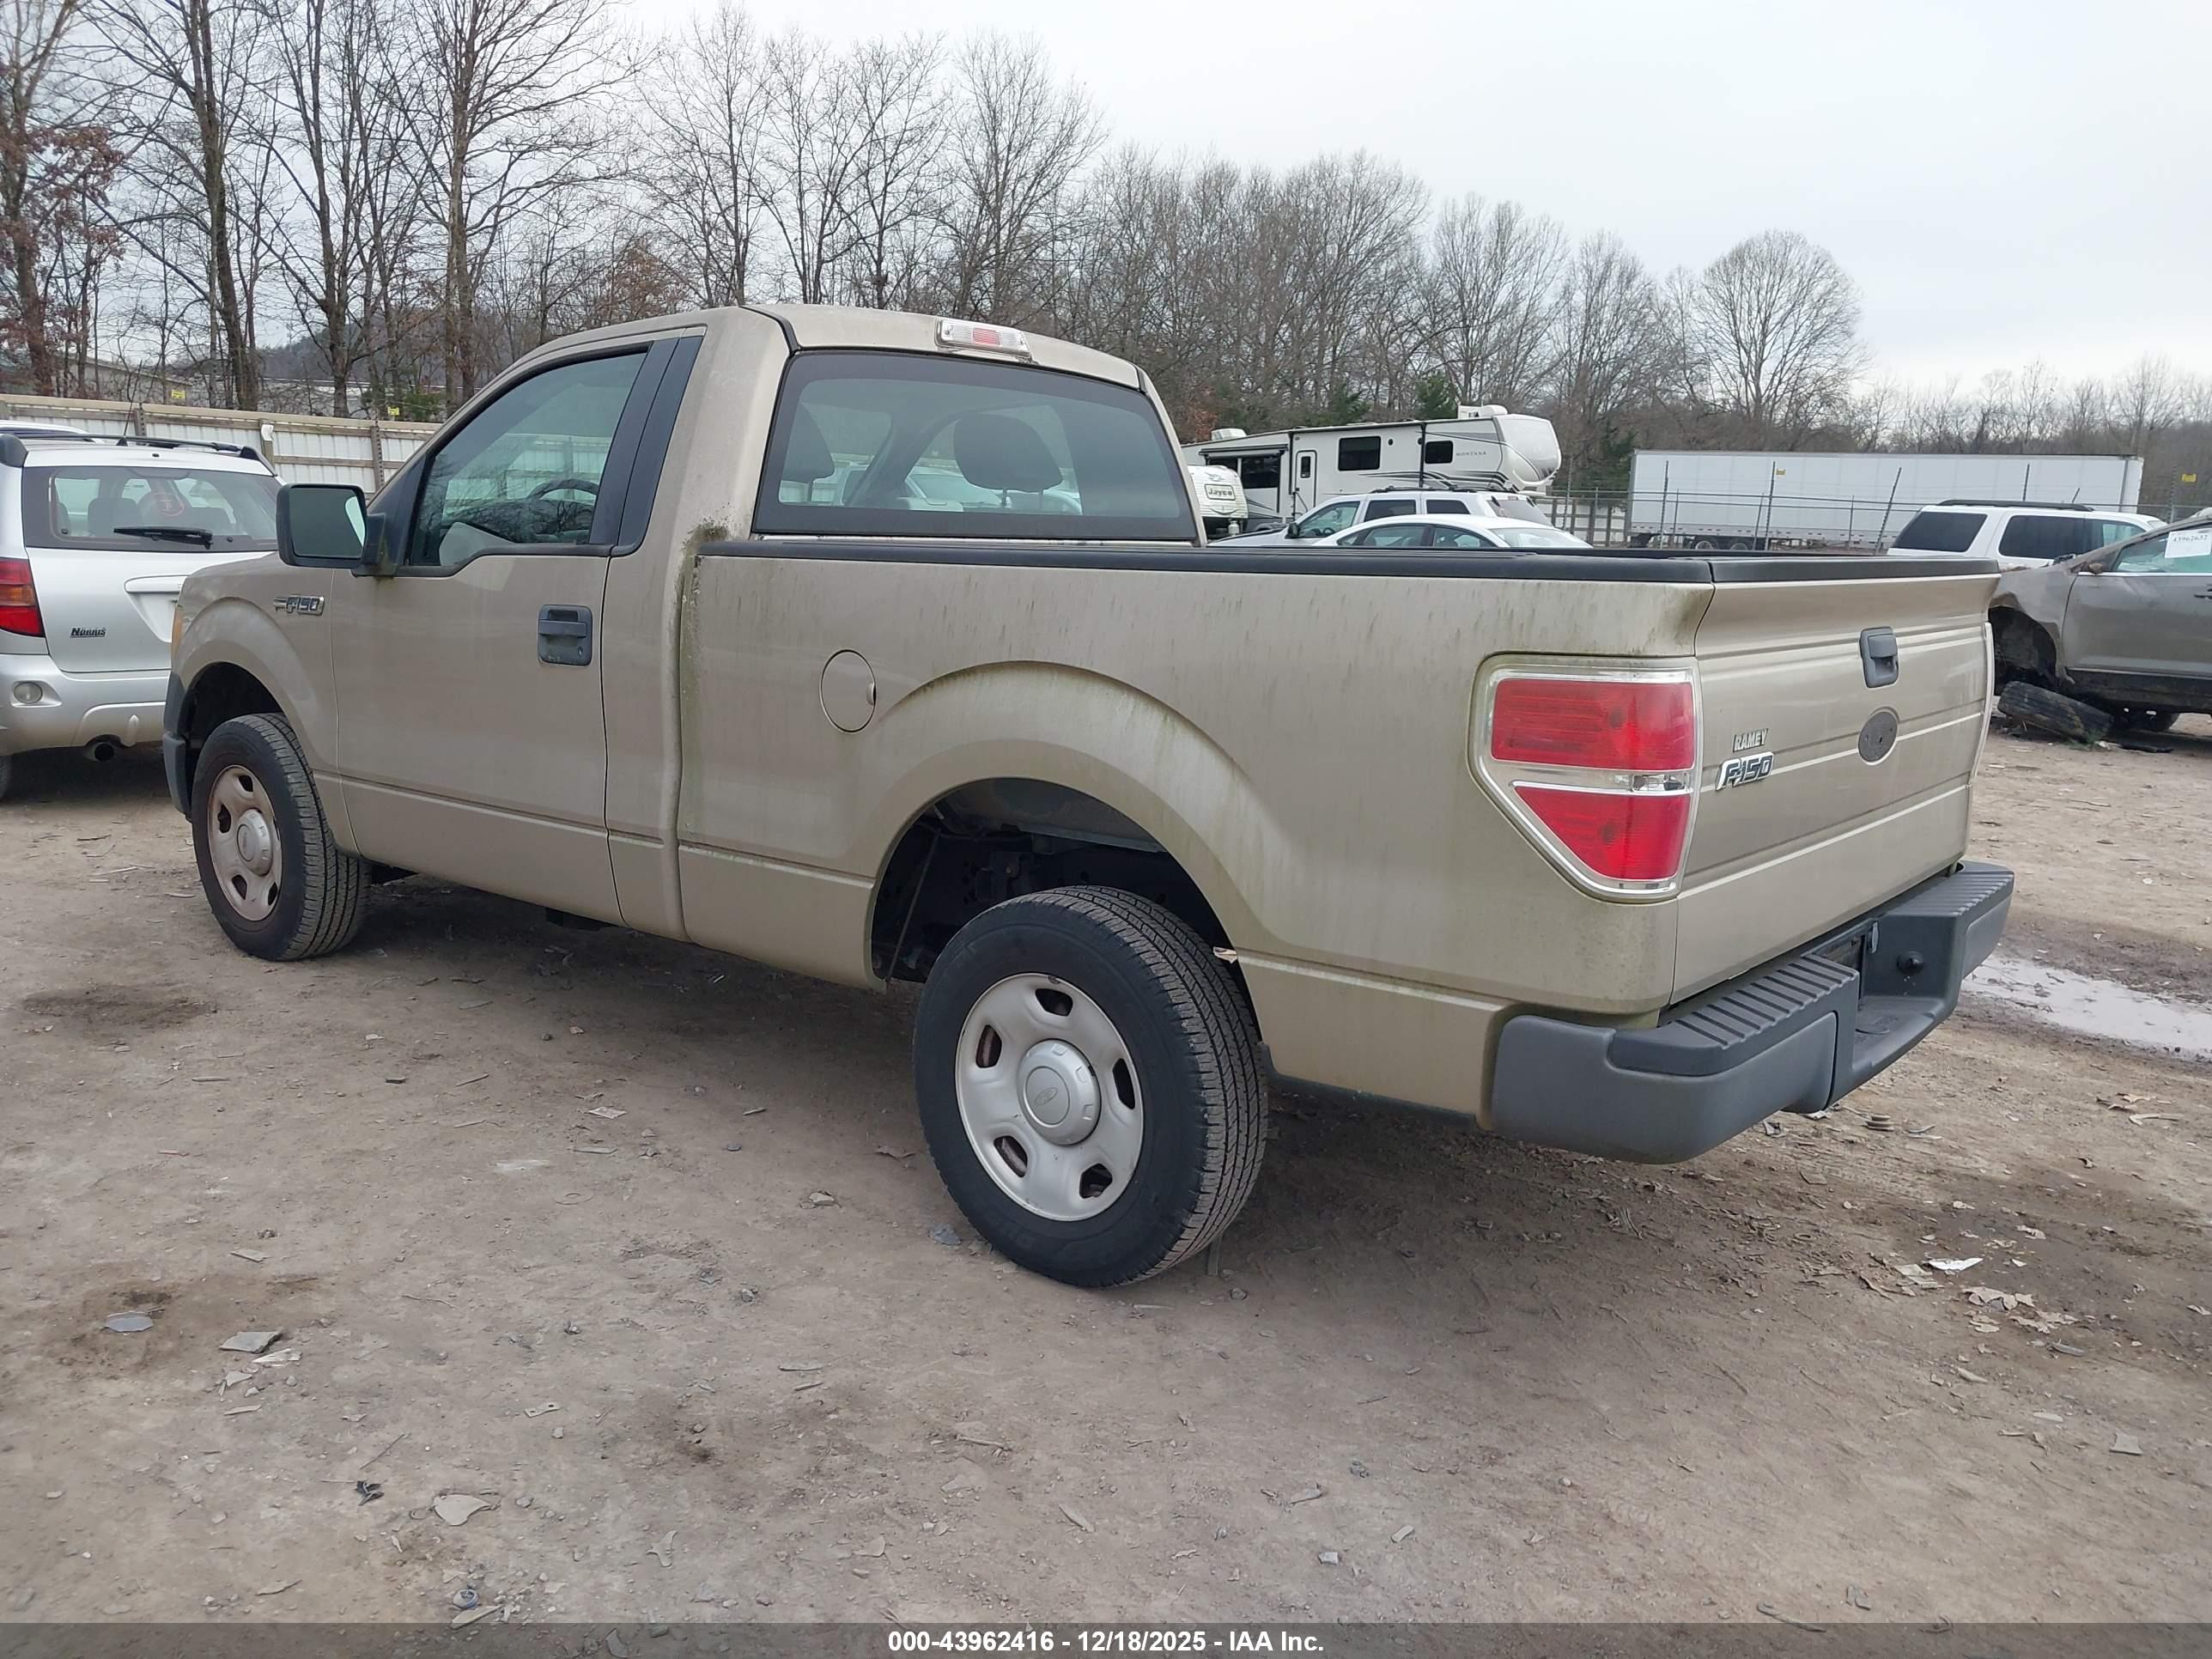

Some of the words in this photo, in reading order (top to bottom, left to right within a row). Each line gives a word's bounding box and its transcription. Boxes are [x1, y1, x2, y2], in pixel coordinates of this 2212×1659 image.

[1208, 488, 1233, 497] Jayco
[1733, 727, 1769, 752] RAMEY
[1716, 751, 1774, 791] F-150
